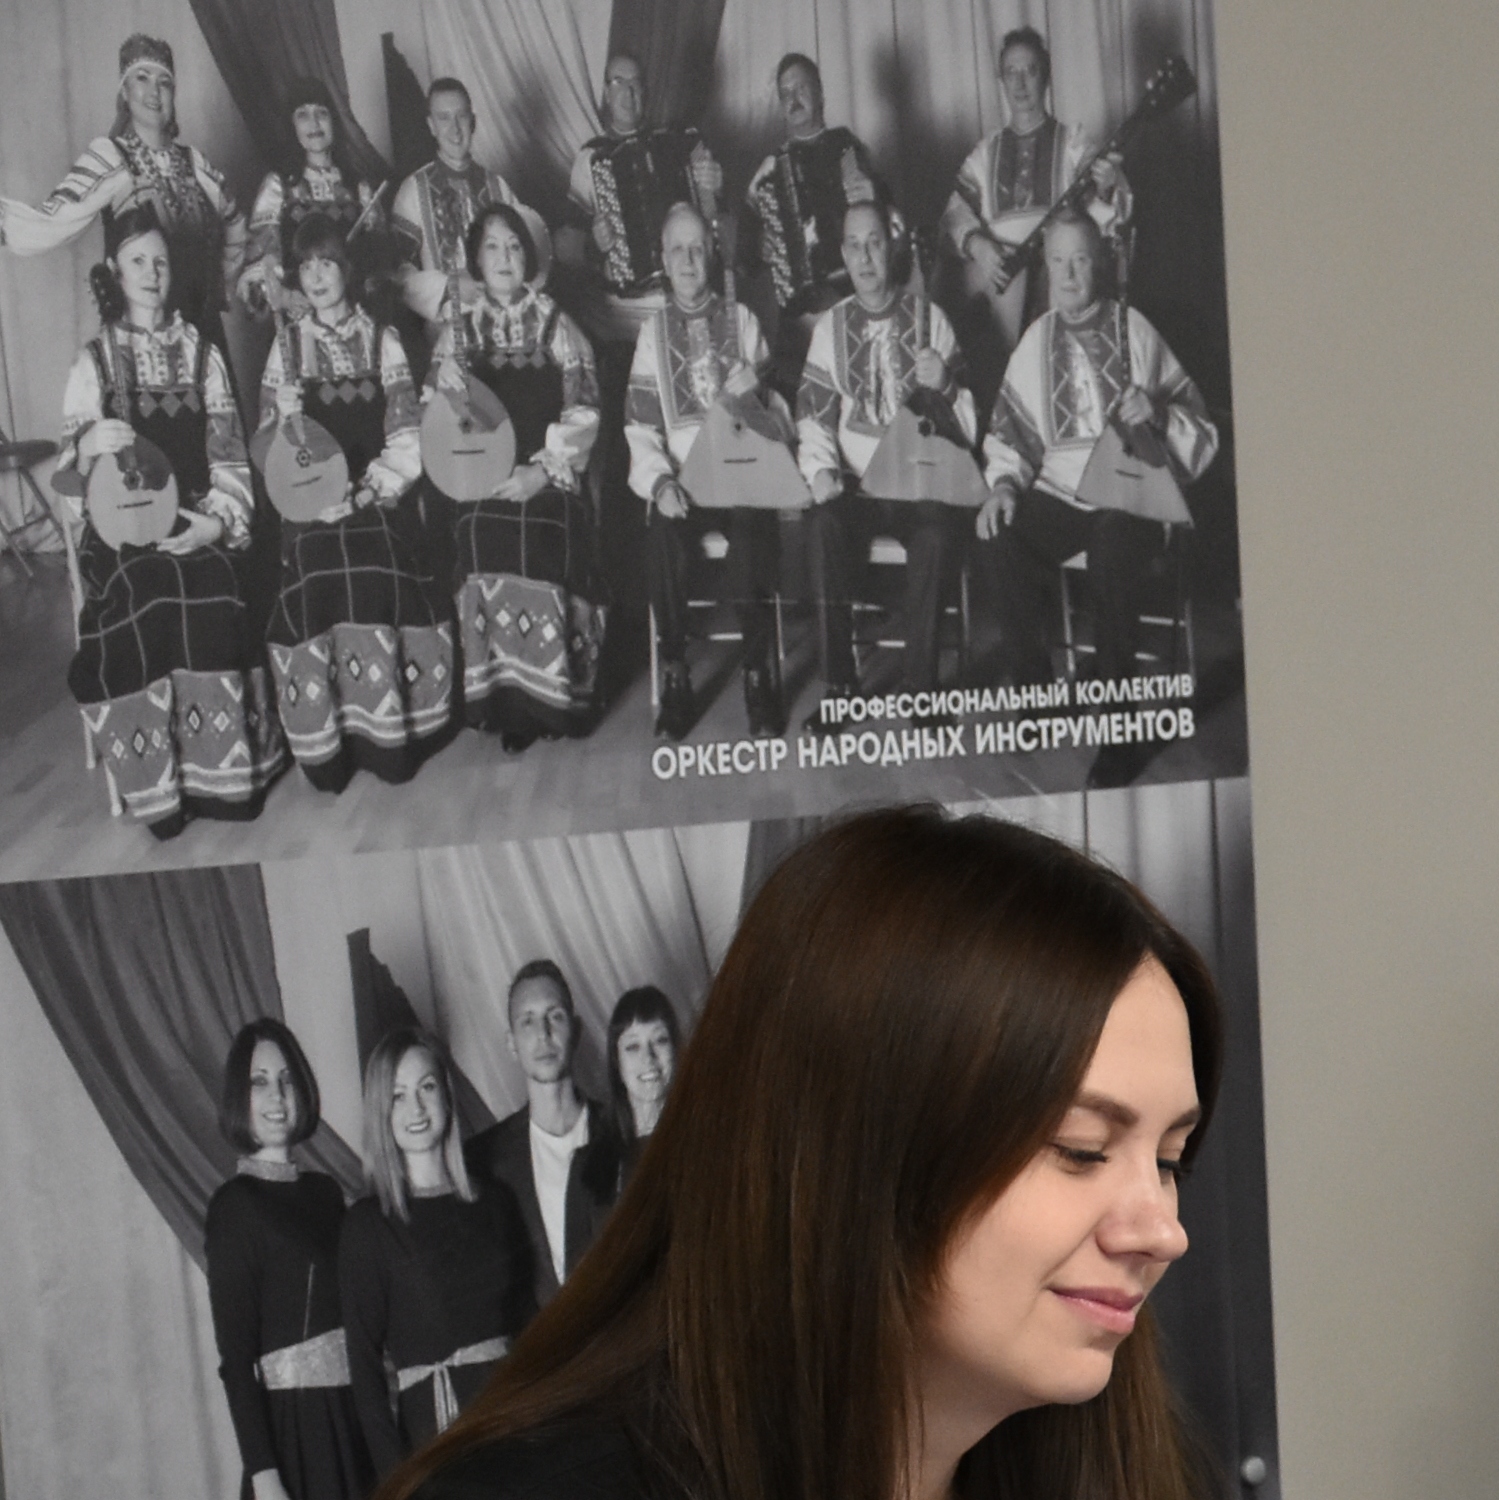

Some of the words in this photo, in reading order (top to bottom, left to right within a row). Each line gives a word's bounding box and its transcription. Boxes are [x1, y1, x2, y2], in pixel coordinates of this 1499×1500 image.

[820, 677, 1071, 725] ПРОФЕССИОНАЛЬНЫЙ
[1075, 673, 1194, 706] КОЛЛЕКТИВ
[652, 736, 787, 780] ОРКЕСТР
[798, 724, 967, 768] НАРОДНЫХ
[975, 706, 1195, 756] ИНСТРУМЕНТОВ
